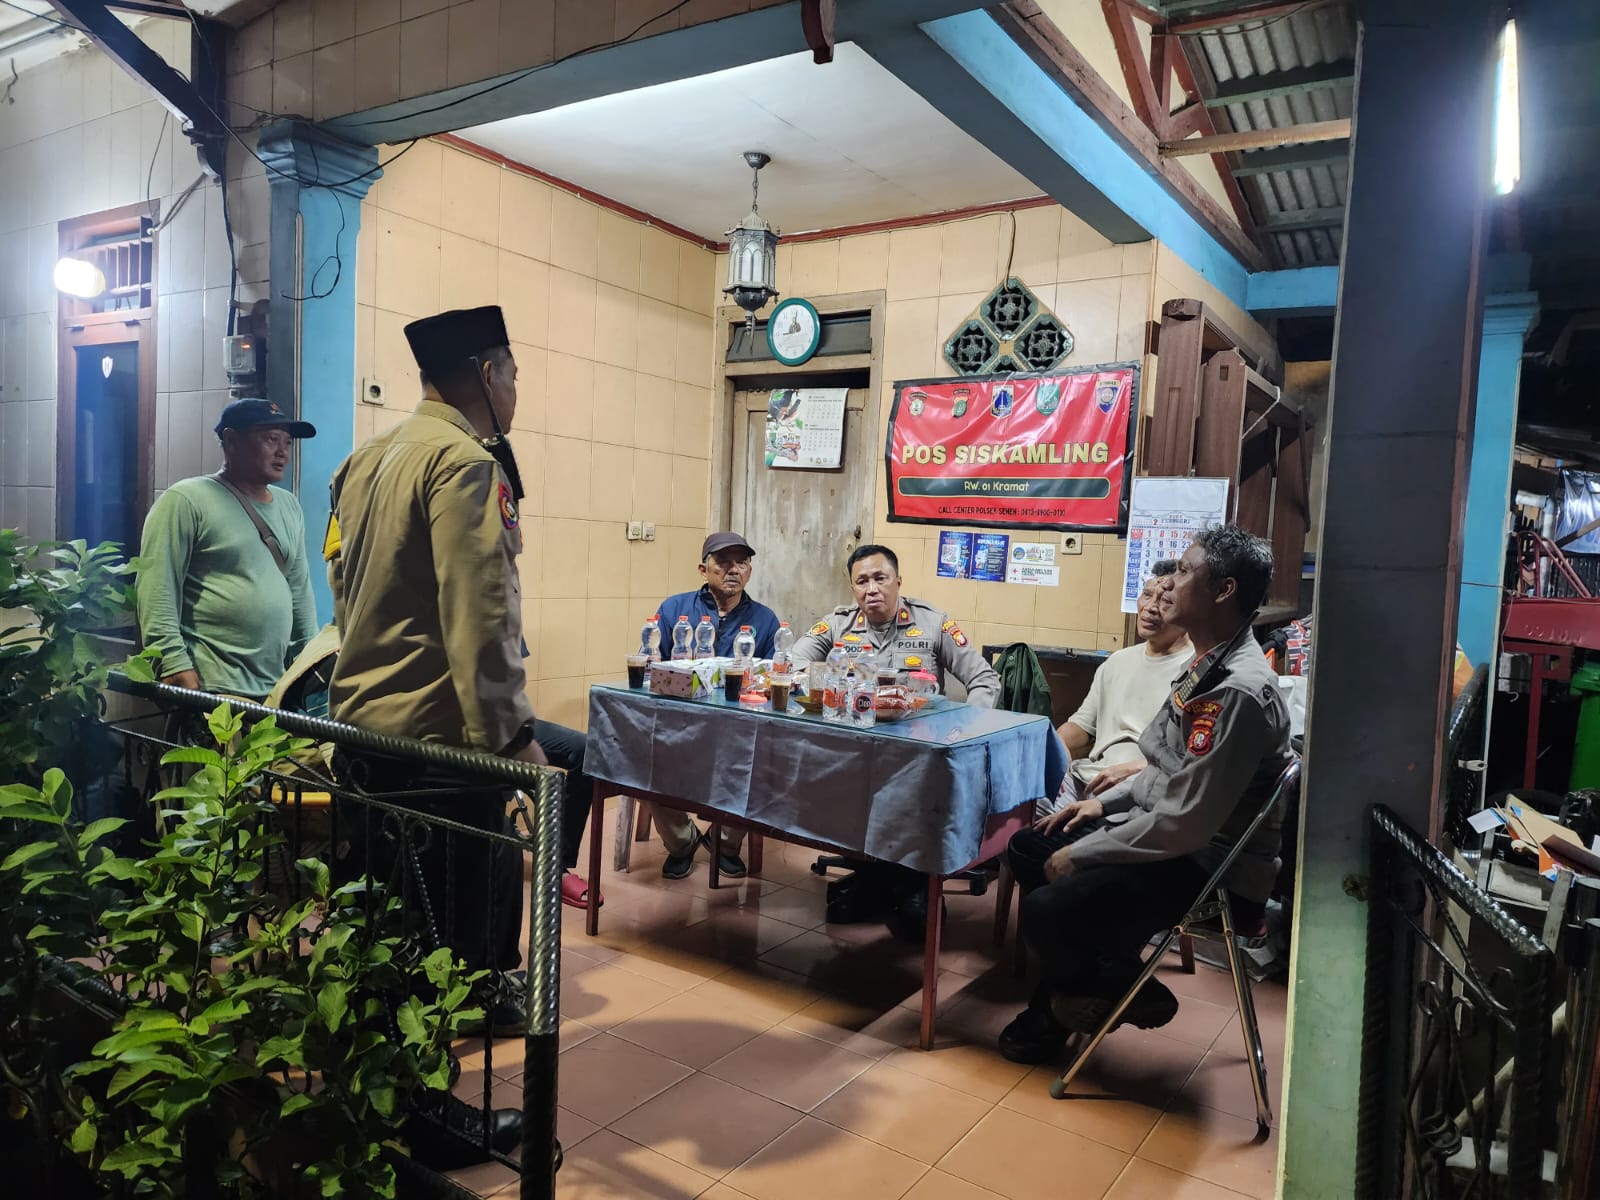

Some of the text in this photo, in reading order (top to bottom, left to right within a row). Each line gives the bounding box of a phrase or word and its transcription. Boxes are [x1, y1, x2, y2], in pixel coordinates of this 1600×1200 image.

[901, 441, 1109, 465] POS SISKAMLING
[992, 481, 1030, 492] Kramat
[938, 506, 952, 514] CALL
[953, 506, 975, 514] CENTER
[1171, 530, 1178, 538] 15
[1159, 540, 1164, 548] 9
[1170, 540, 1178, 548] 16
[1145, 550, 1176, 558] 3 10 17
[898, 641, 928, 649] POLRI
